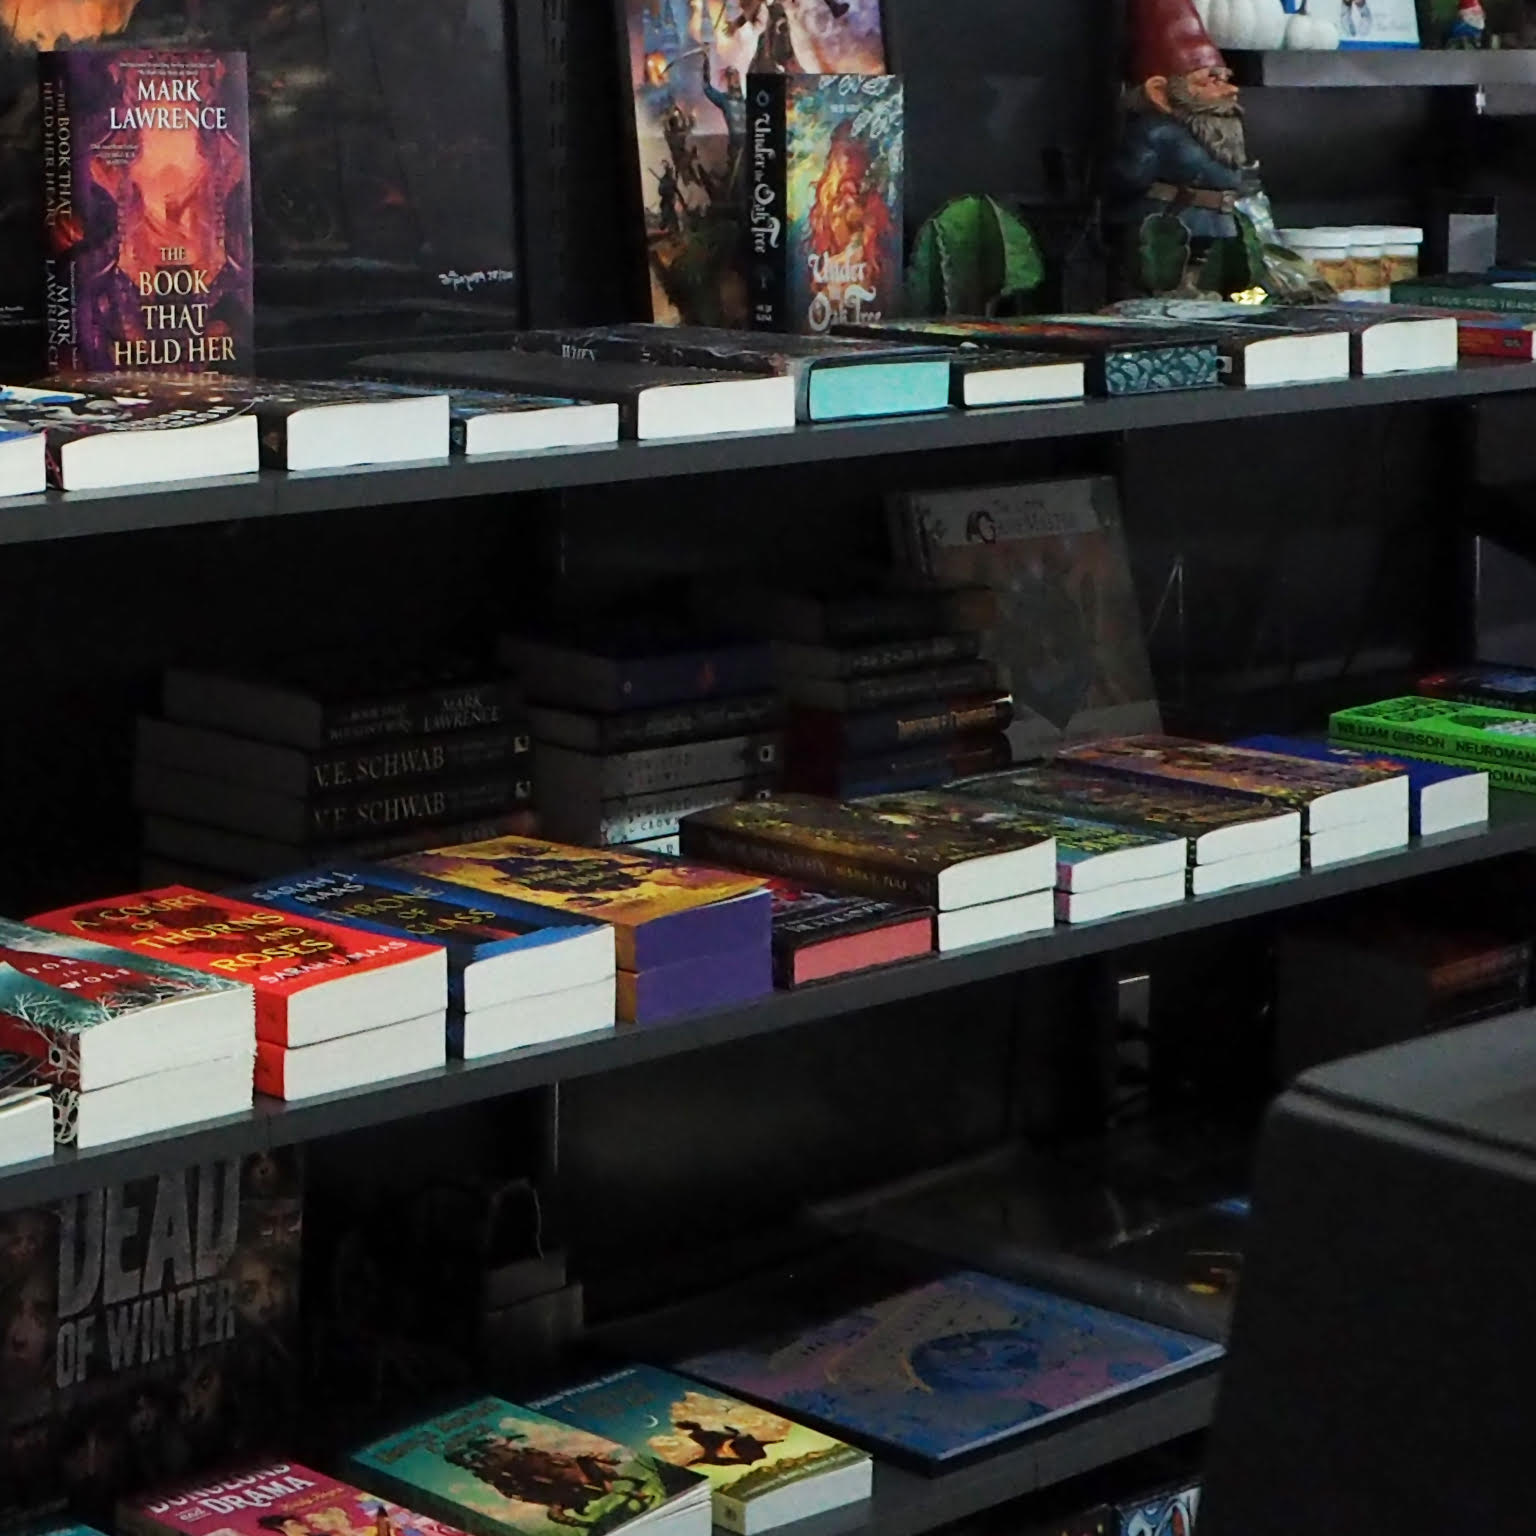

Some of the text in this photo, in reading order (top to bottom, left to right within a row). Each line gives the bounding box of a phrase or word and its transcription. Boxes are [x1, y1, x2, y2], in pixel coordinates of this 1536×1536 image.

[137, 79, 202, 103] MARK
[110, 106, 227, 131] LAWRENCE
[139, 270, 210, 296] BOOK
[141, 304, 206, 335] THAT
[114, 336, 235, 365] HELD HER
[1336, 721, 1445, 748] WILLIAM GIBSON
[356, 745, 448, 780] SCHWAB
[71, 894, 208, 931] A COURT
[131, 919, 161, 931] OF
[405, 907, 496, 935] GLASS
[132, 912, 284, 950] THORNS
[255, 926, 305, 943] AND
[211, 939, 335, 972] ROSES
[57, 1164, 240, 1321] DEAD
[55, 1282, 236, 1390] OF WINTER
[198, 1475, 316, 1514] DRAMA
